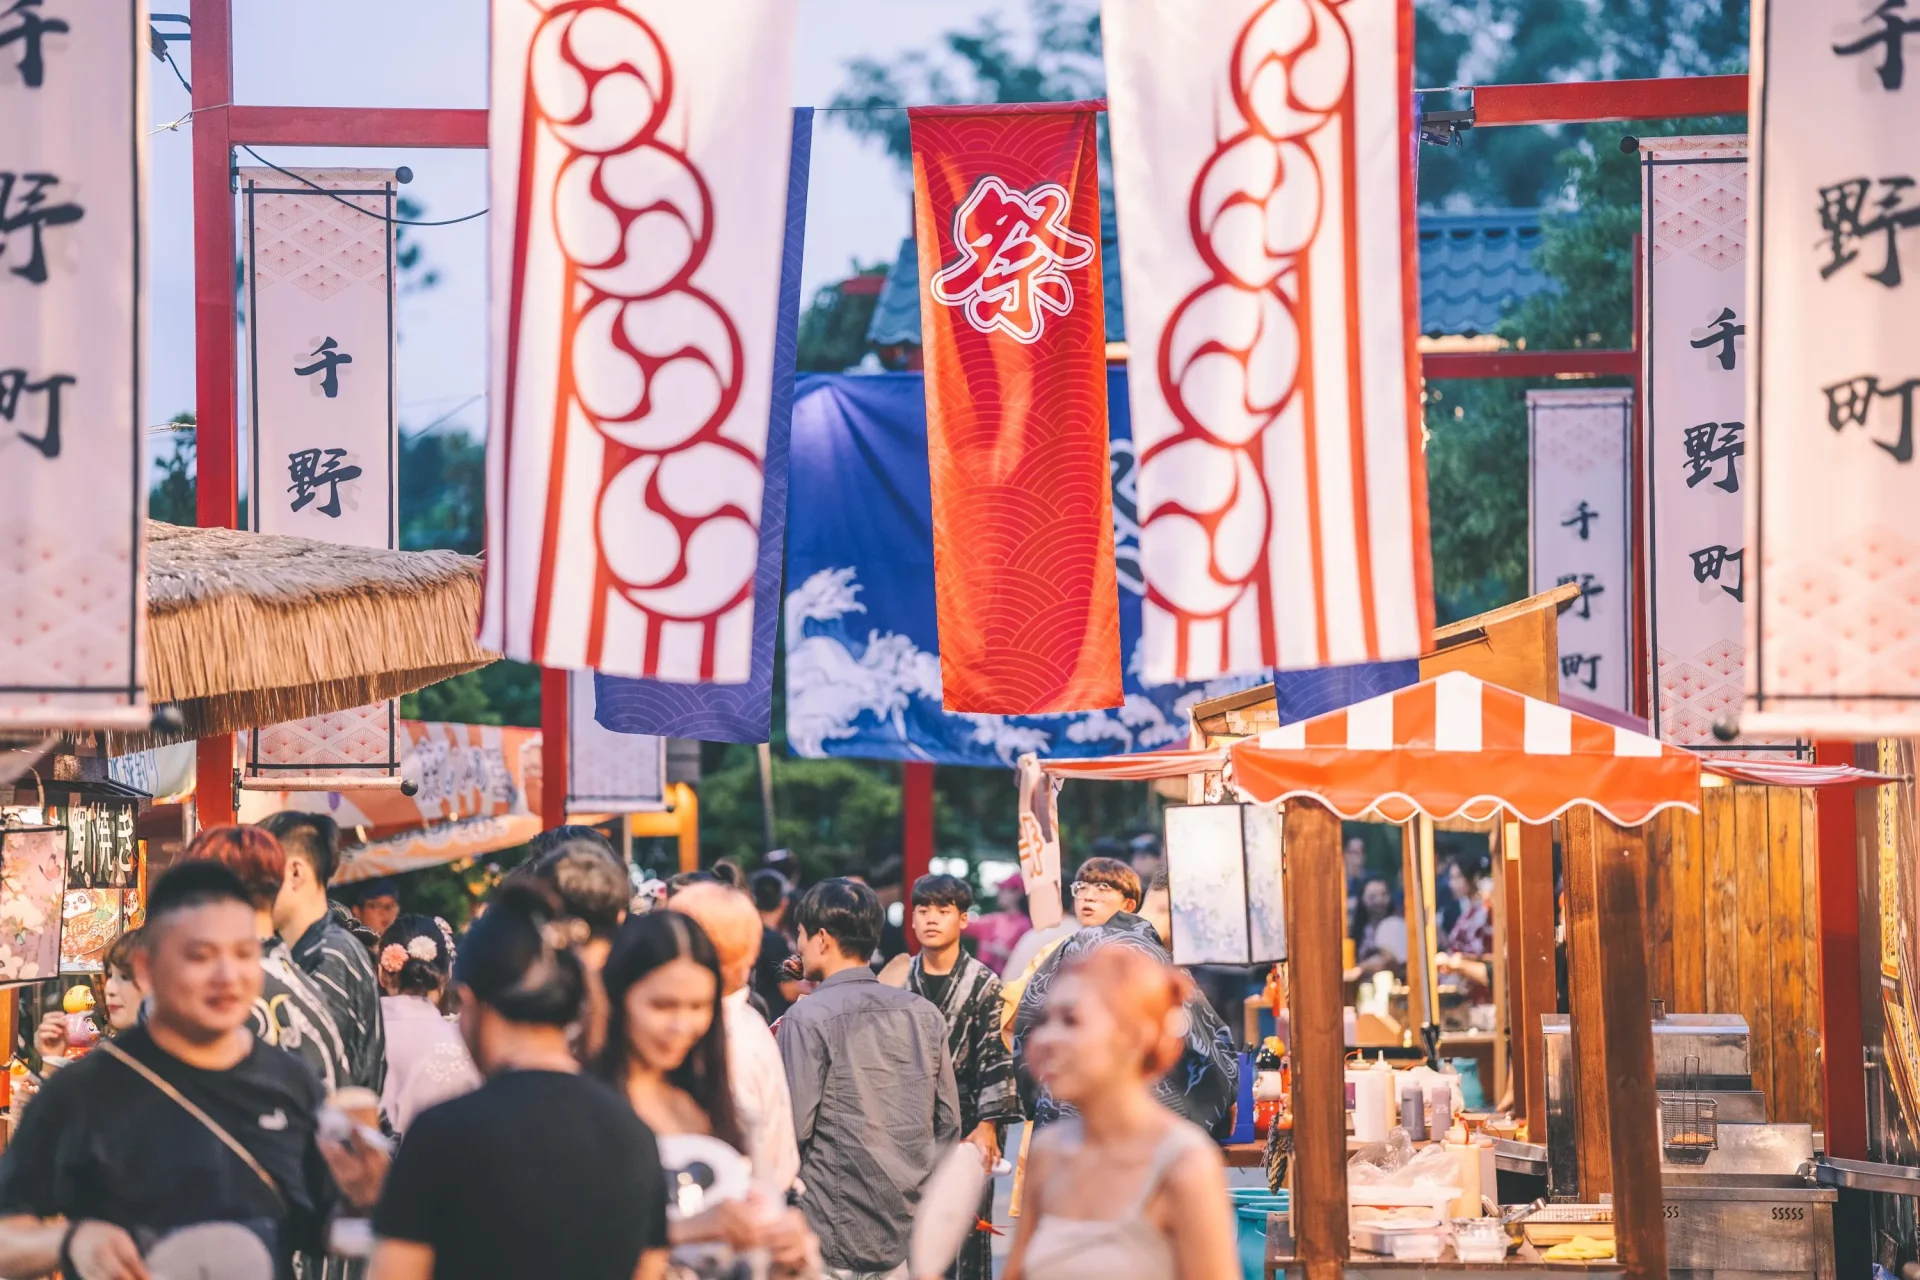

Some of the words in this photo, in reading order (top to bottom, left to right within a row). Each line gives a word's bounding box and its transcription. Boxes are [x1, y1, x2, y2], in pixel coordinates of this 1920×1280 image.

[931, 176, 1096, 344] 祭
[1816, 0, 1920, 463] 千野町
[288, 337, 363, 518] 千野
[1683, 307, 1745, 603] 千野町
[1556, 500, 1605, 690] 千野町
